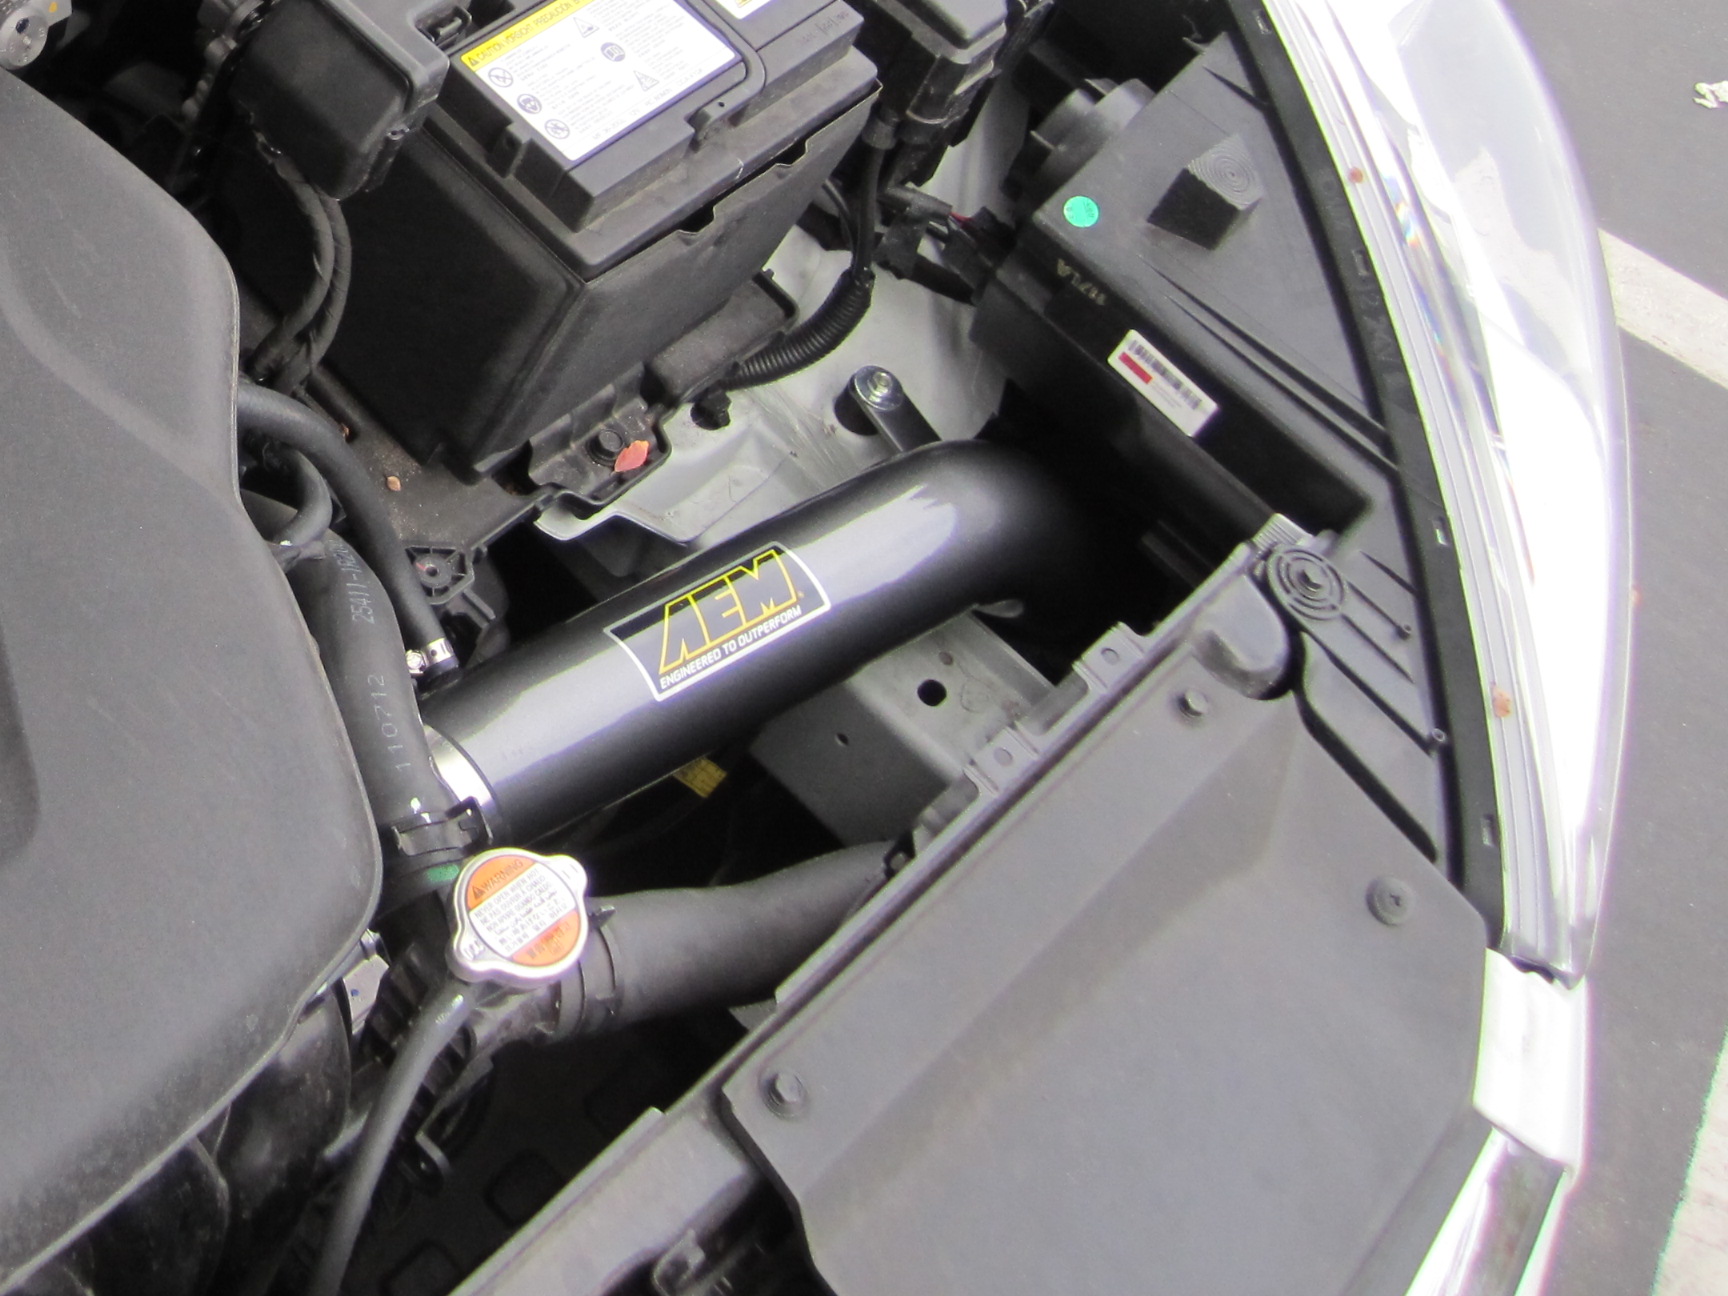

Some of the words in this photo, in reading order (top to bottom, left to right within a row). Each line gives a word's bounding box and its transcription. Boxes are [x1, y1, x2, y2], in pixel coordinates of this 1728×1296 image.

[659, 549, 798, 675] AEM
[659, 648, 722, 690] ENGINEERED
[722, 640, 737, 656] TO
[738, 604, 802, 648] OUTPERFORM
[367, 674, 412, 772] 110712
[481, 858, 523, 891] WARNING
